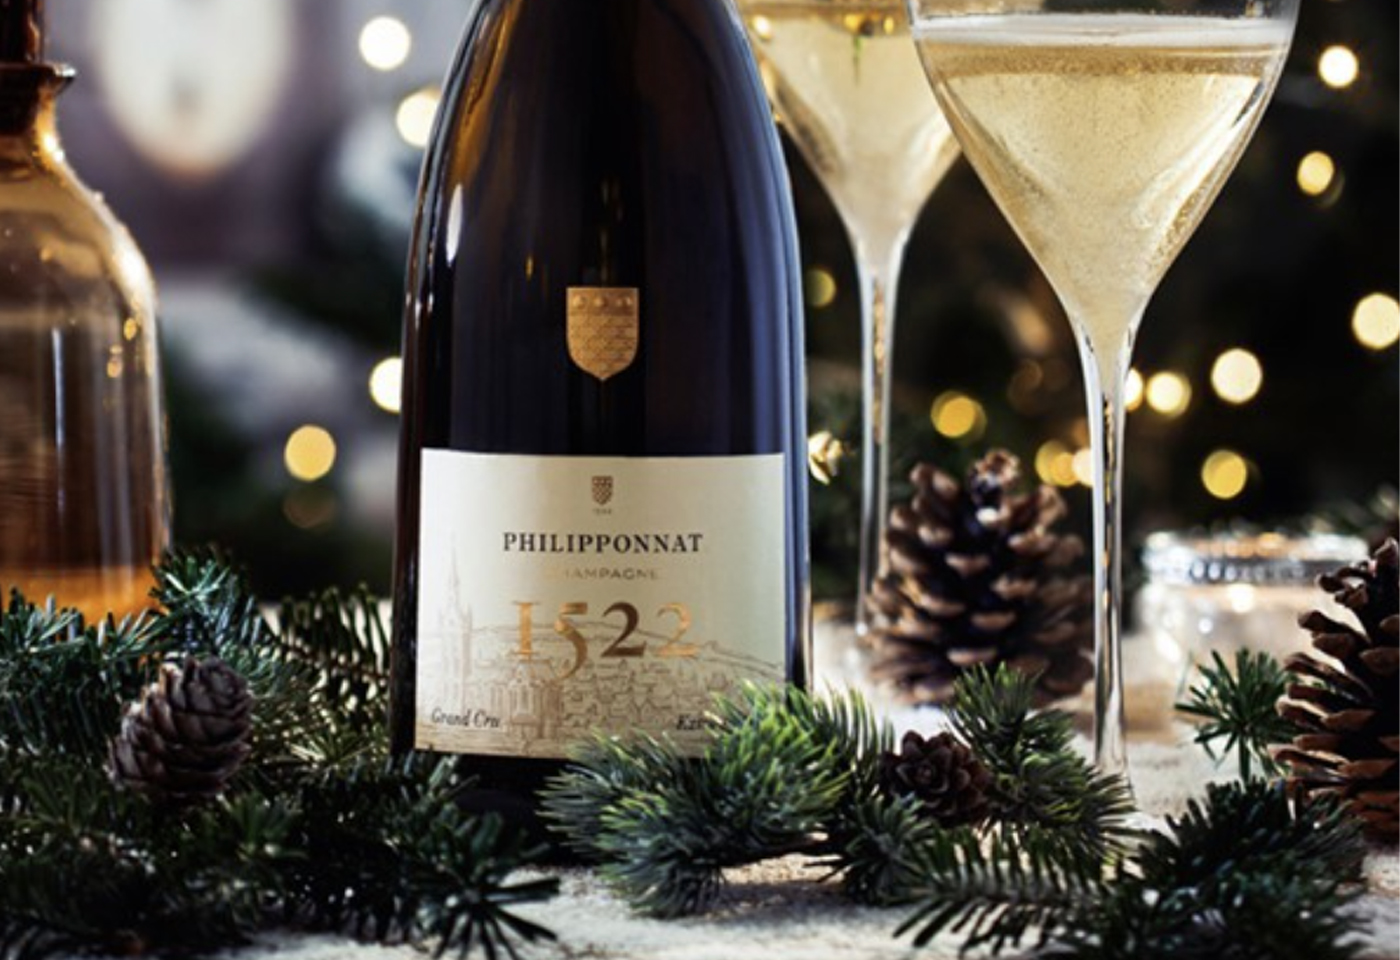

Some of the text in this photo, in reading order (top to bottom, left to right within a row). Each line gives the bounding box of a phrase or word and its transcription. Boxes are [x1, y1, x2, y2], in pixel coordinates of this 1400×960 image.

[503, 532, 703, 554] PHILIPPONNAT
[511, 601, 699, 679] 1522
[431, 707, 501, 728] Grand Cru
